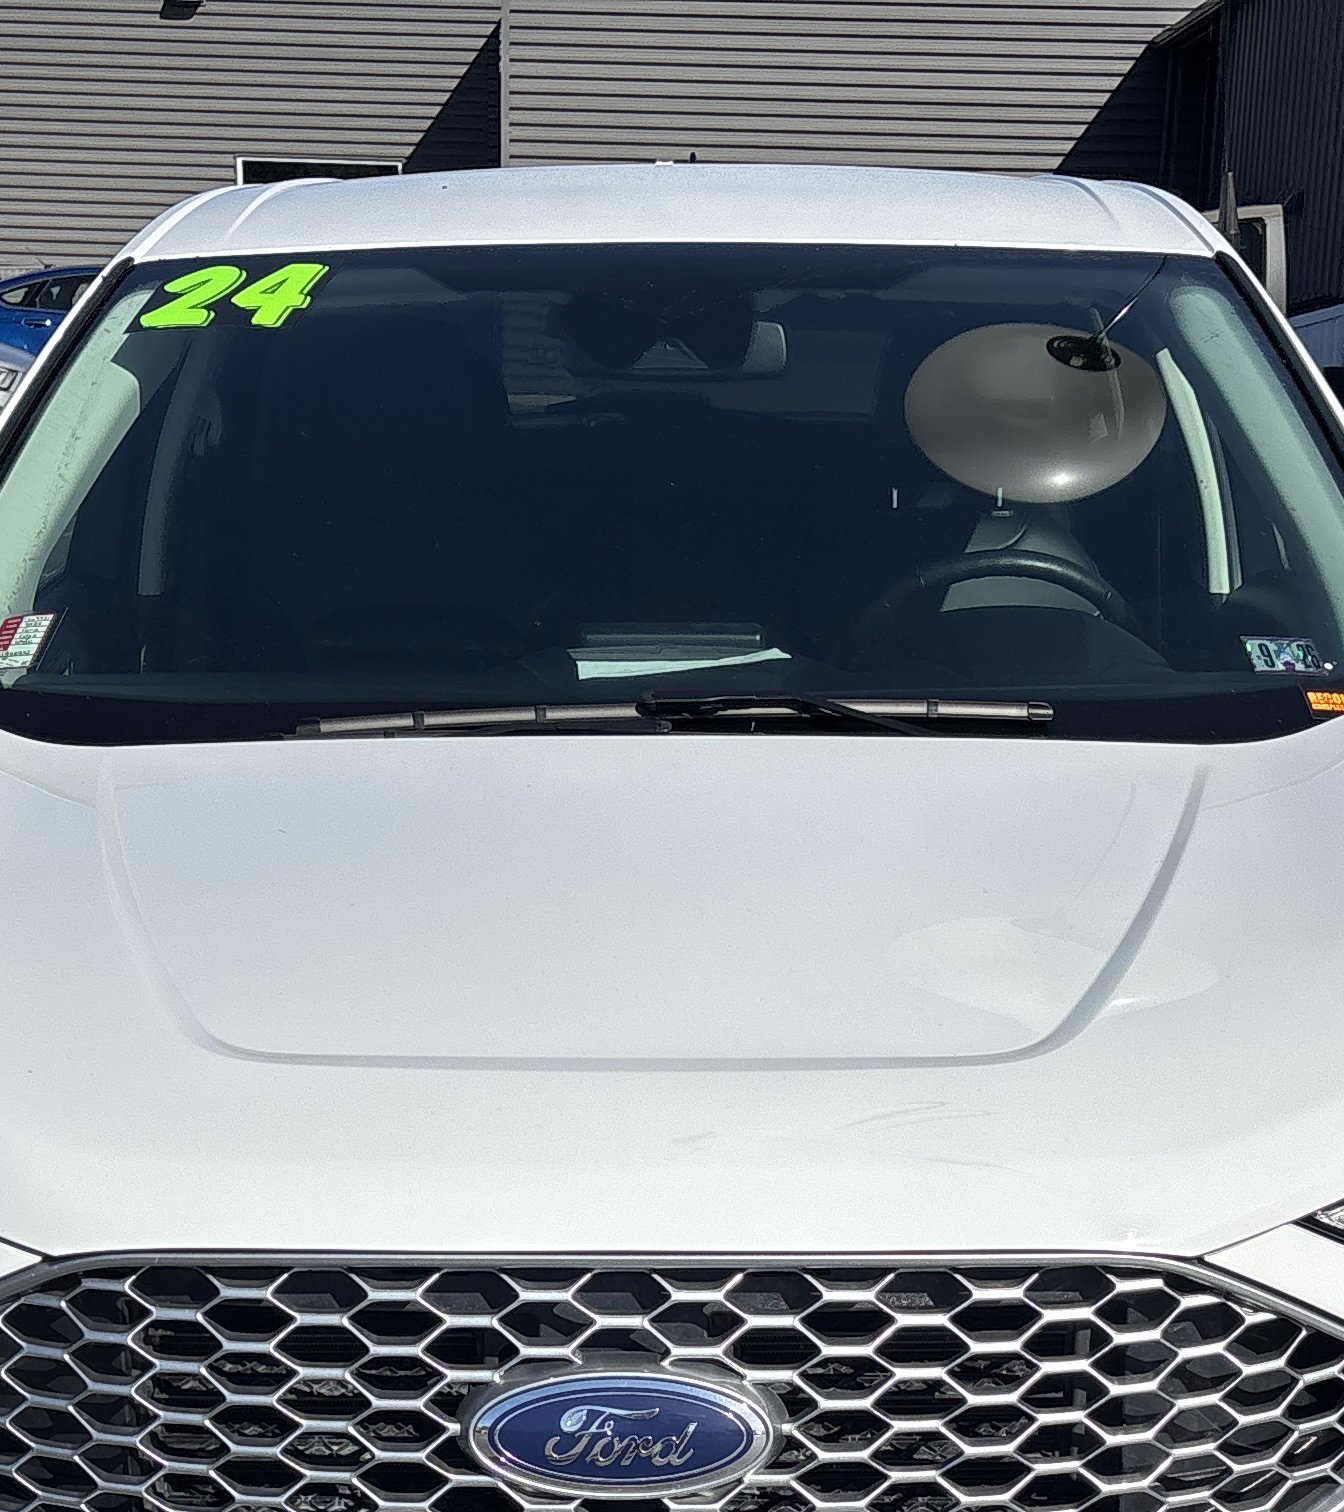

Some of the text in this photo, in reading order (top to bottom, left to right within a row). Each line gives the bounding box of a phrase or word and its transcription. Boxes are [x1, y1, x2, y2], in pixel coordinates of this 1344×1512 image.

[139, 263, 330, 329] 24
[1257, 643, 1276, 669] 9
[543, 1404, 699, 1469] Ford
